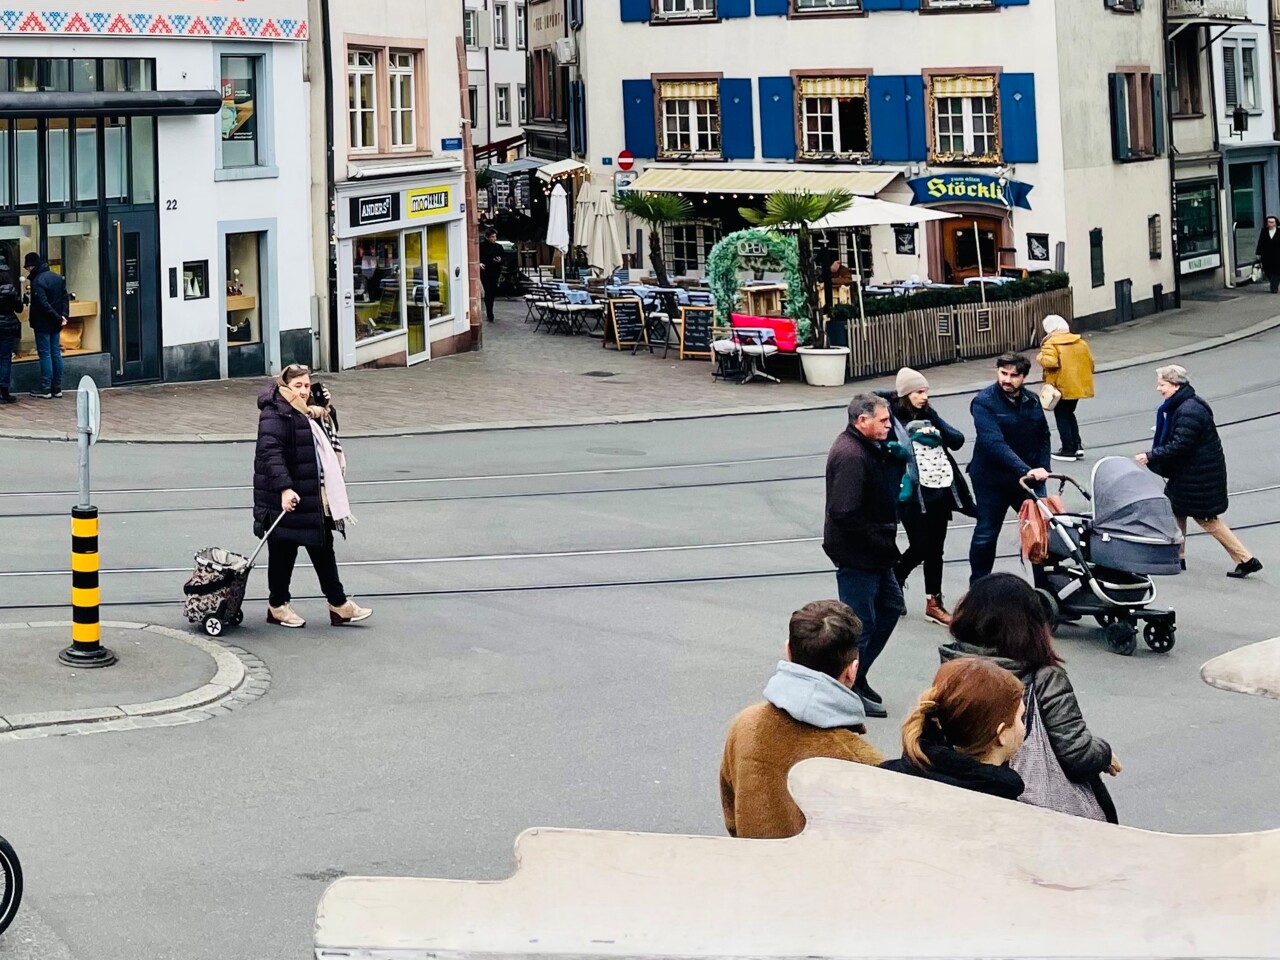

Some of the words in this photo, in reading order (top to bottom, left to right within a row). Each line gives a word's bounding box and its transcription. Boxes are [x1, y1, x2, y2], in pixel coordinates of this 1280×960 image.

[926, 178, 1001, 200] Stöckli
[166, 199, 178, 211] 22
[739, 241, 767, 254] OPEN
